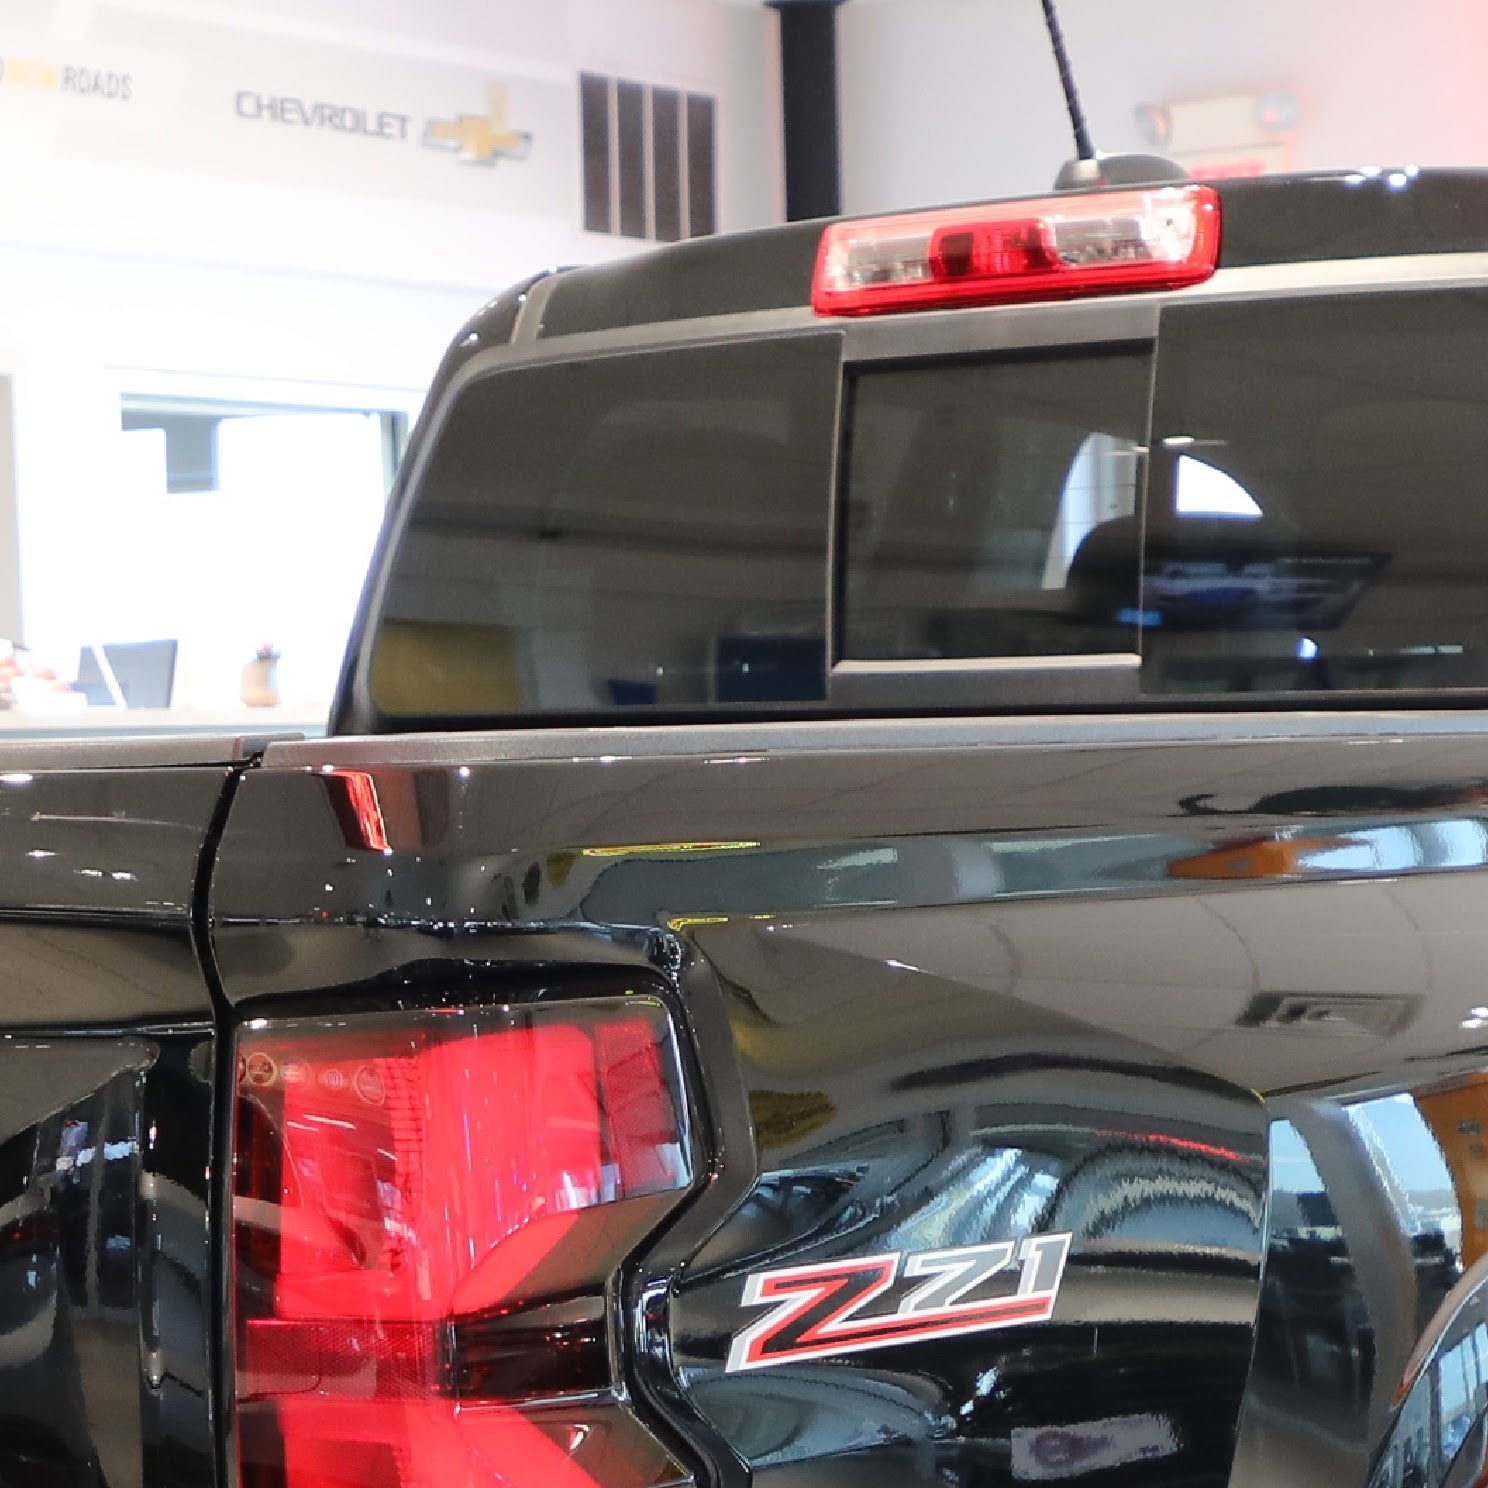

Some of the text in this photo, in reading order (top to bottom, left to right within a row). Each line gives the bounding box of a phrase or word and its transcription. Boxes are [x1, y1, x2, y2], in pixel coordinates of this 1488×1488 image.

[62, 65, 133, 102] ROADS
[234, 90, 411, 141] CHEVROLET
[725, 1231, 1073, 1373] Z71
